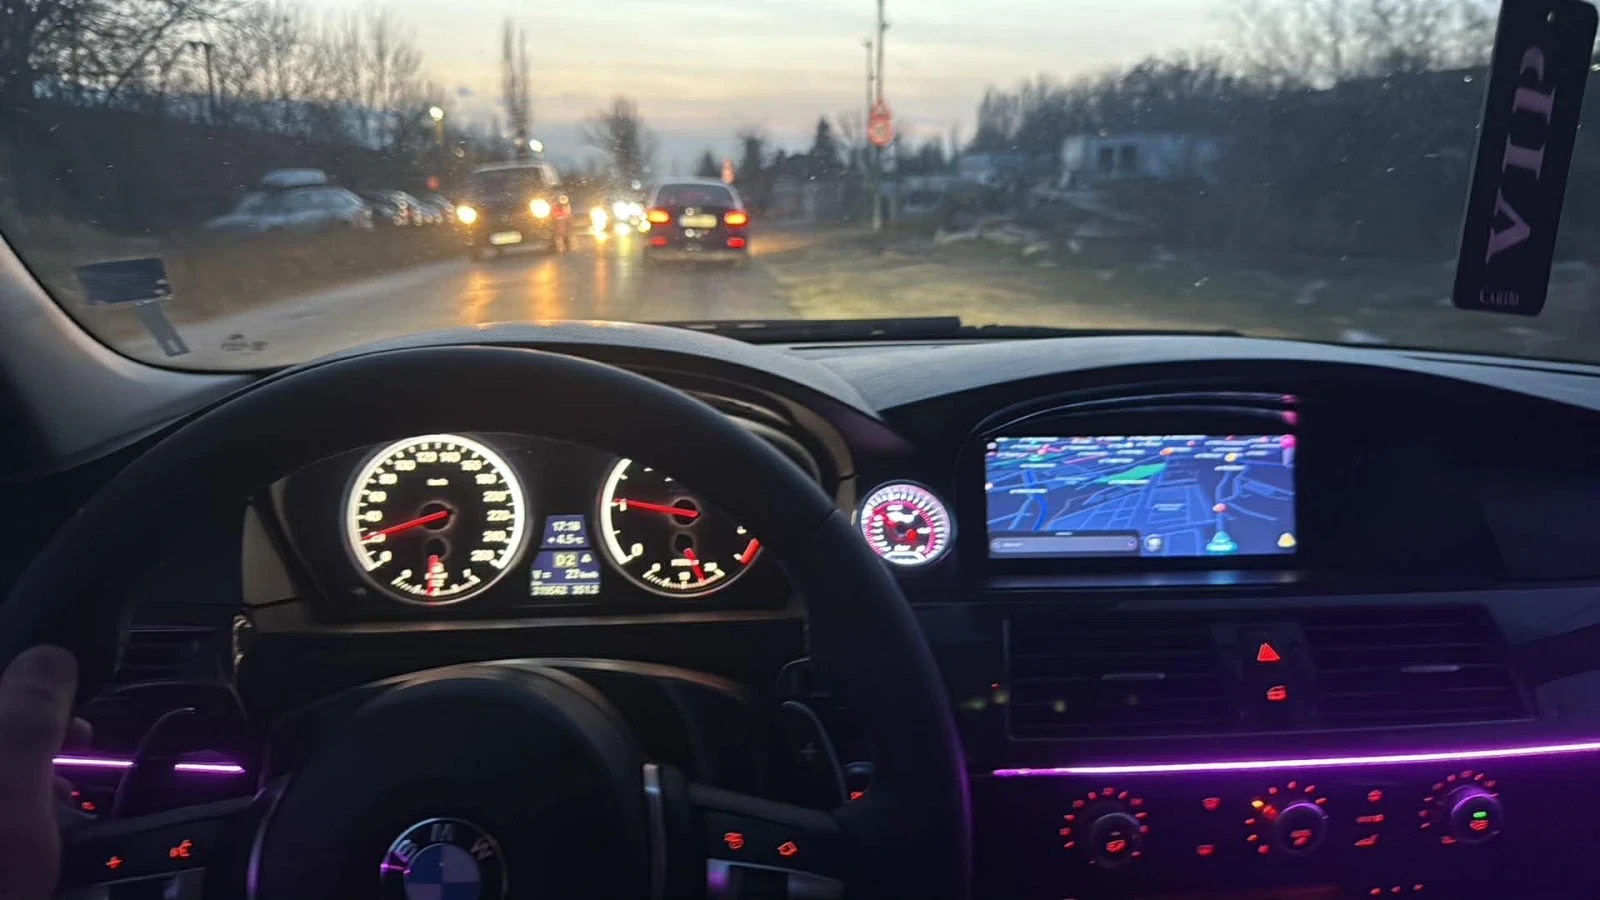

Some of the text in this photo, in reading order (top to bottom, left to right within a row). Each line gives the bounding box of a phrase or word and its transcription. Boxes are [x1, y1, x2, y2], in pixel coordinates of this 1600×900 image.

[1485, 45, 1556, 266] VIP
[415, 451, 437, 463] 120
[439, 451, 461, 463] 140
[483, 491, 507, 503] 200
[487, 509, 511, 522] 220
[482, 530, 507, 543] 240
[555, 553, 576, 569] D2
[394, 823, 494, 862] BMW
